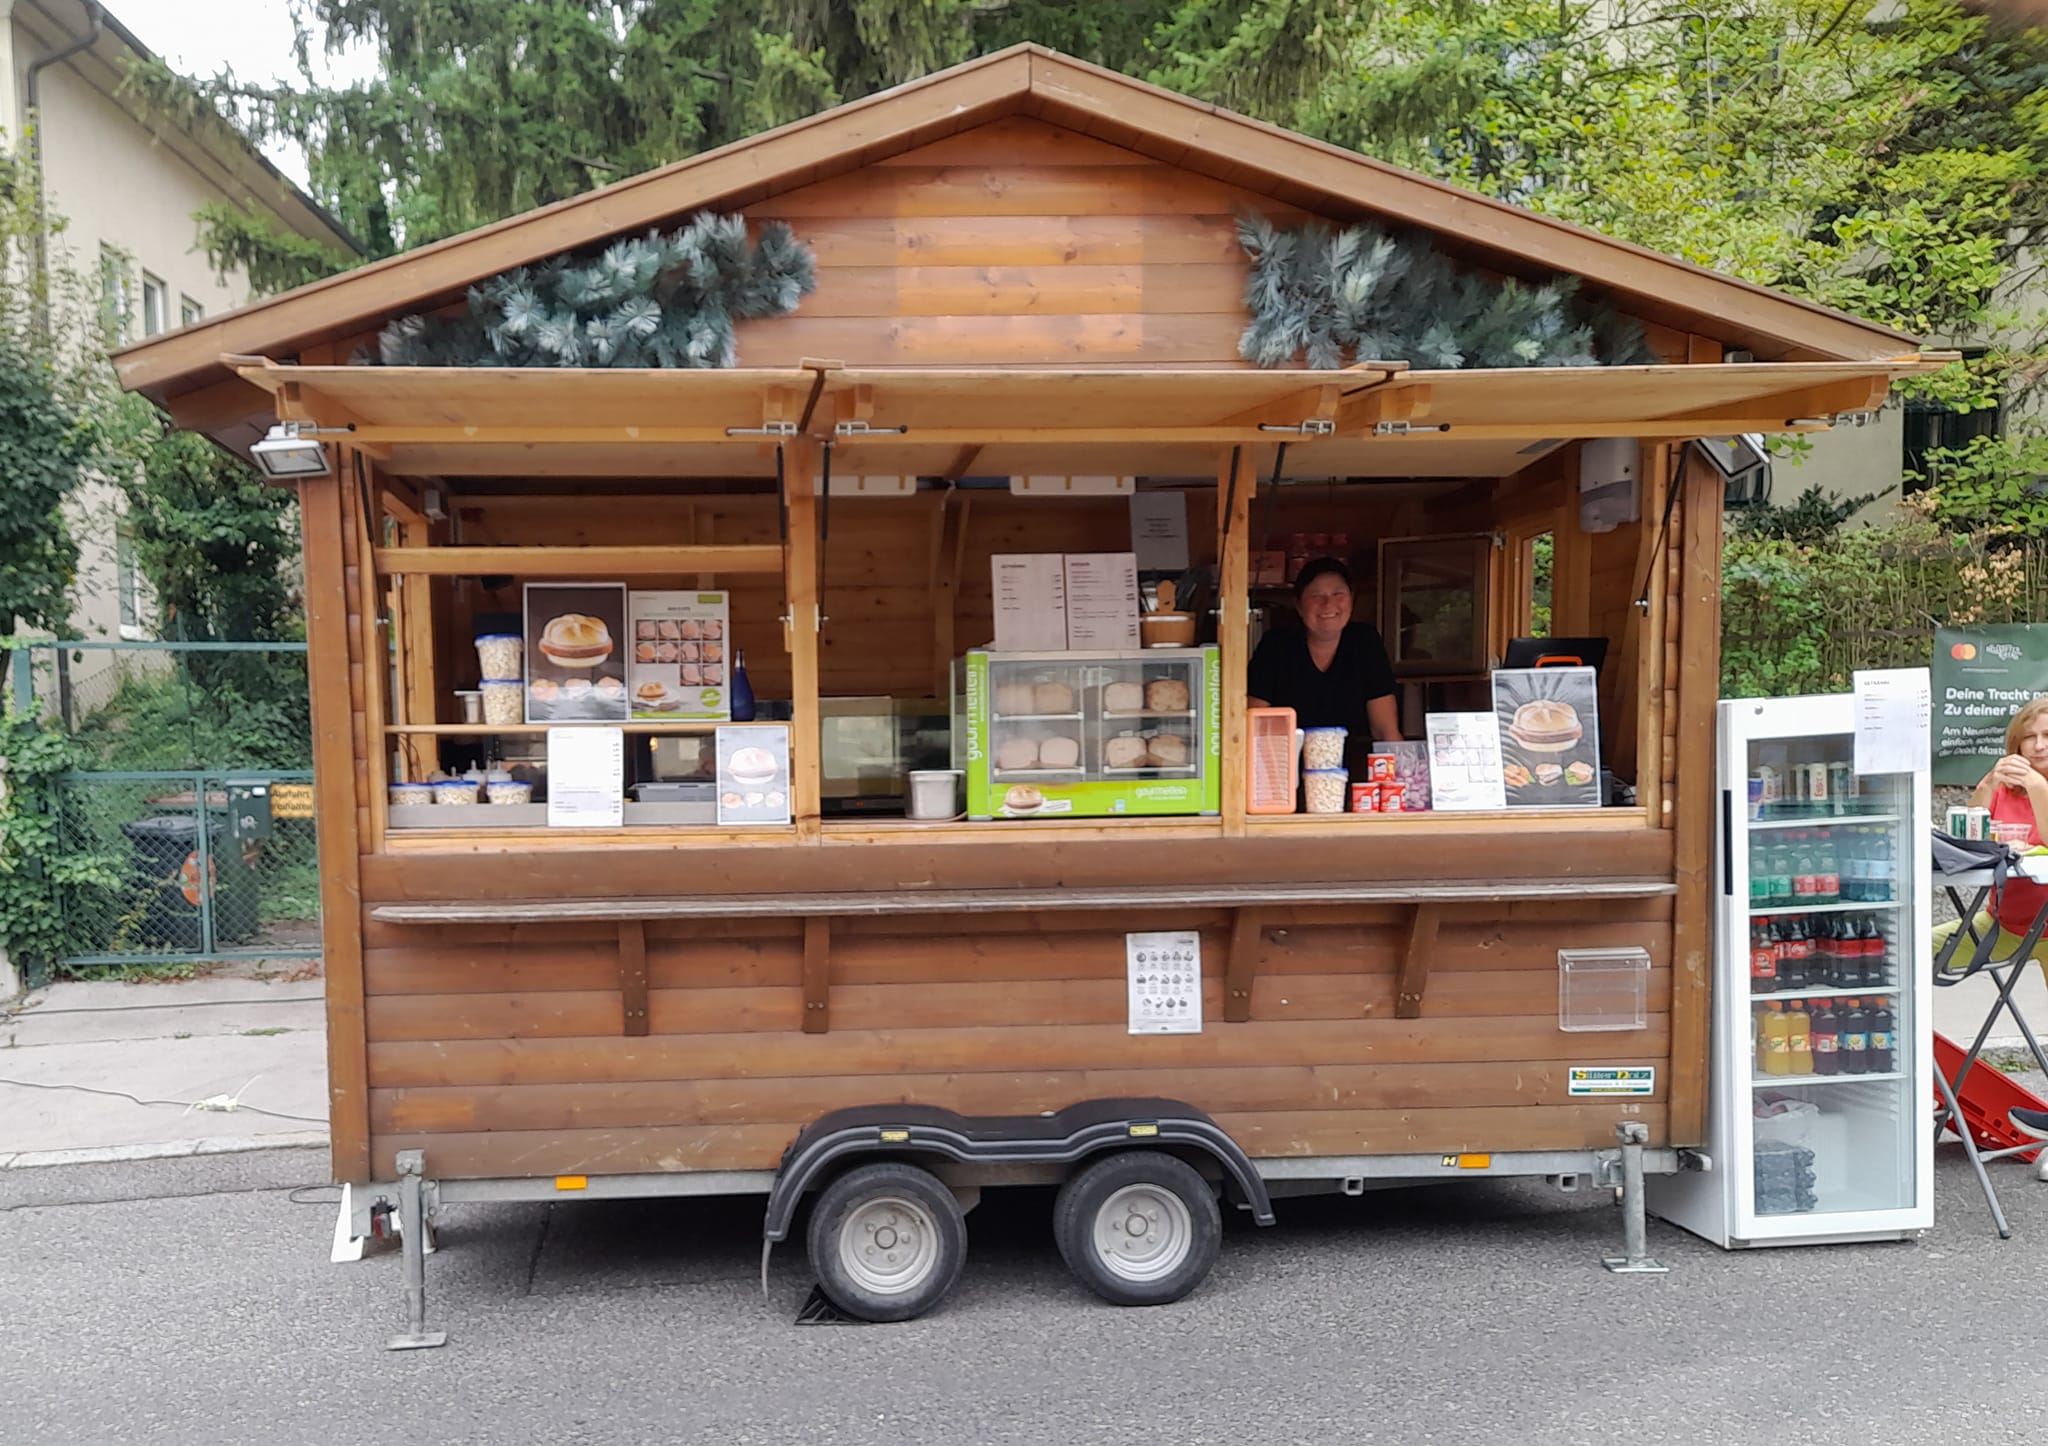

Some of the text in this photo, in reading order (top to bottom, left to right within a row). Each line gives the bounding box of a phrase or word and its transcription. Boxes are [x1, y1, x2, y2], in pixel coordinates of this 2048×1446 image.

[1946, 687, 1984, 700] Deine
[1987, 688, 2030, 700] Tracht
[1944, 703, 1962, 716] Zu
[1964, 704, 2006, 716] deiner
[1942, 726, 1960, 737] Am
